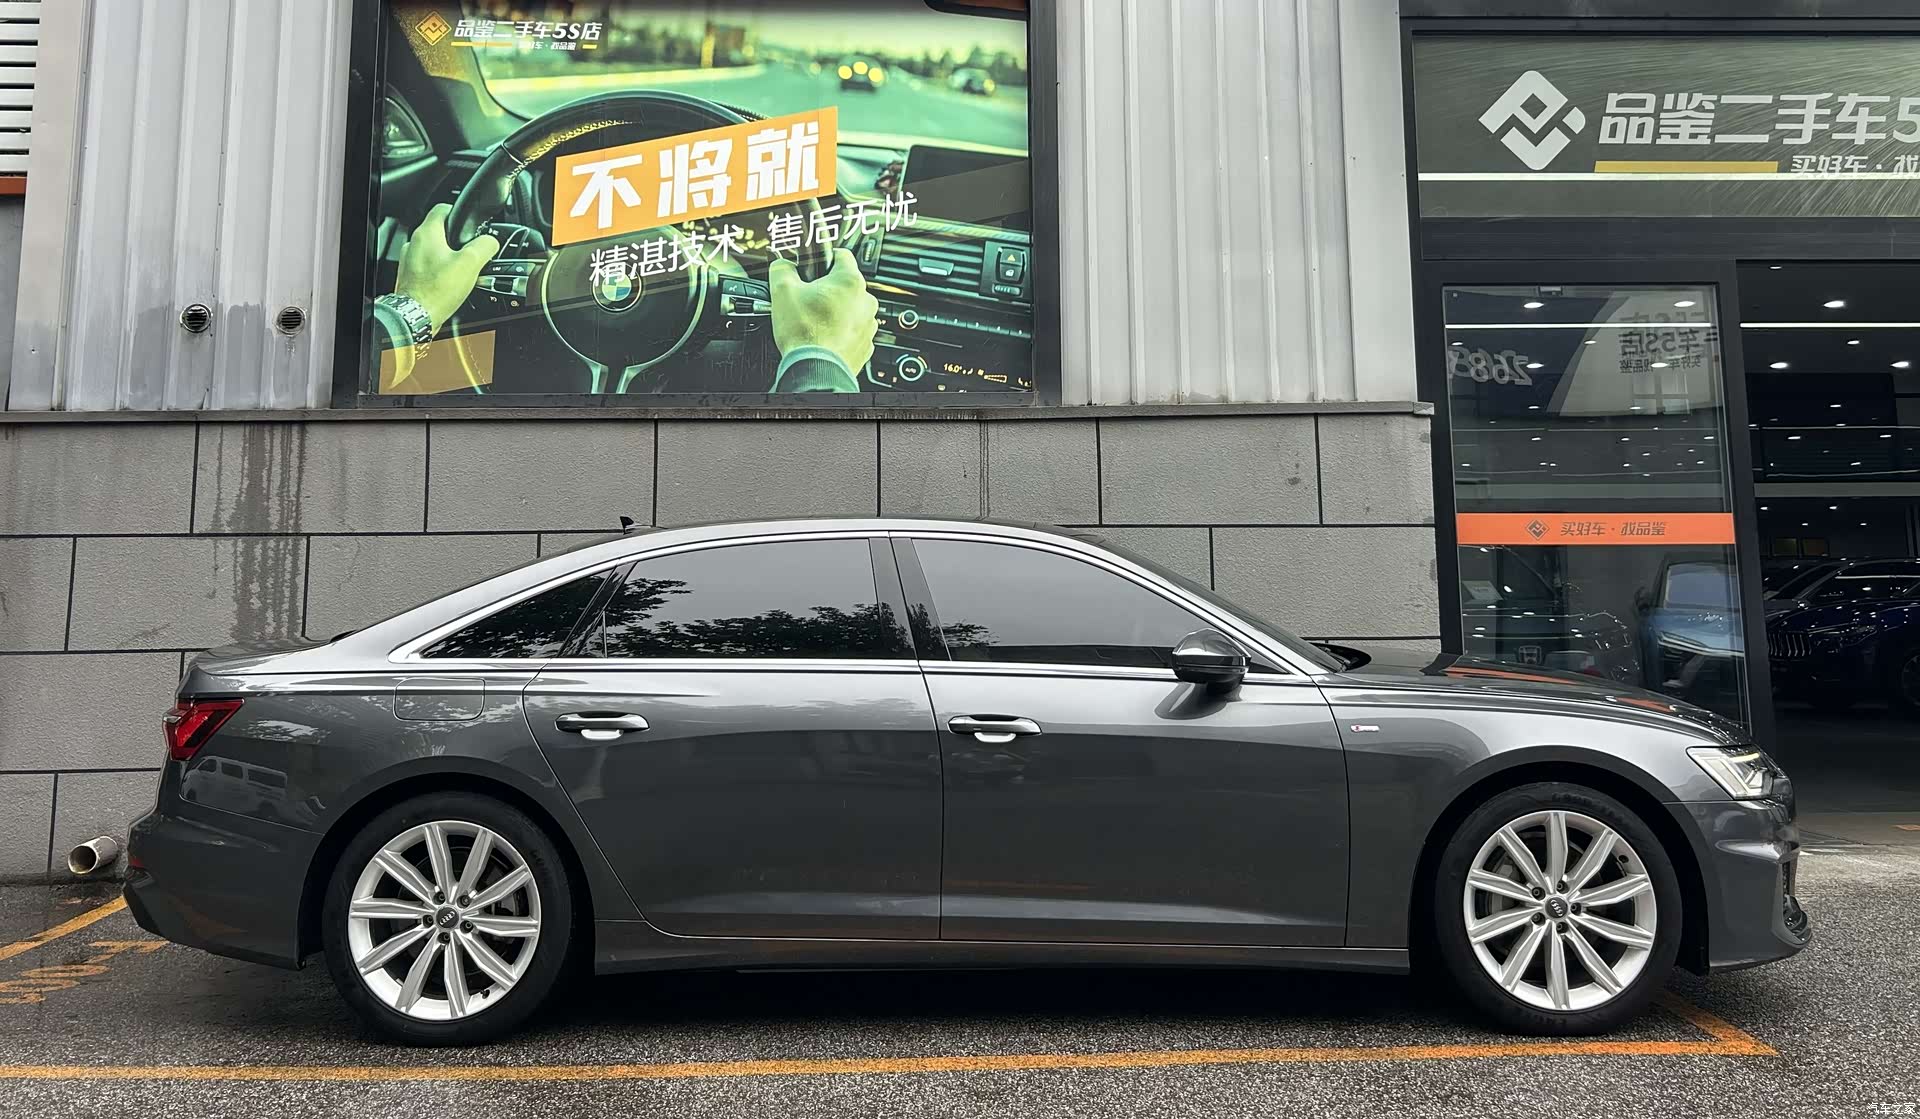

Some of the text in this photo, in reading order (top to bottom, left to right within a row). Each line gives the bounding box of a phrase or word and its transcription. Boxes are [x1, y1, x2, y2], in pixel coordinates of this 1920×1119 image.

[454, 20, 603, 41] 品鉴二手车5S店
[570, 121, 819, 229] 不将就
[589, 191, 918, 287] 精湛技术 售后无忧
